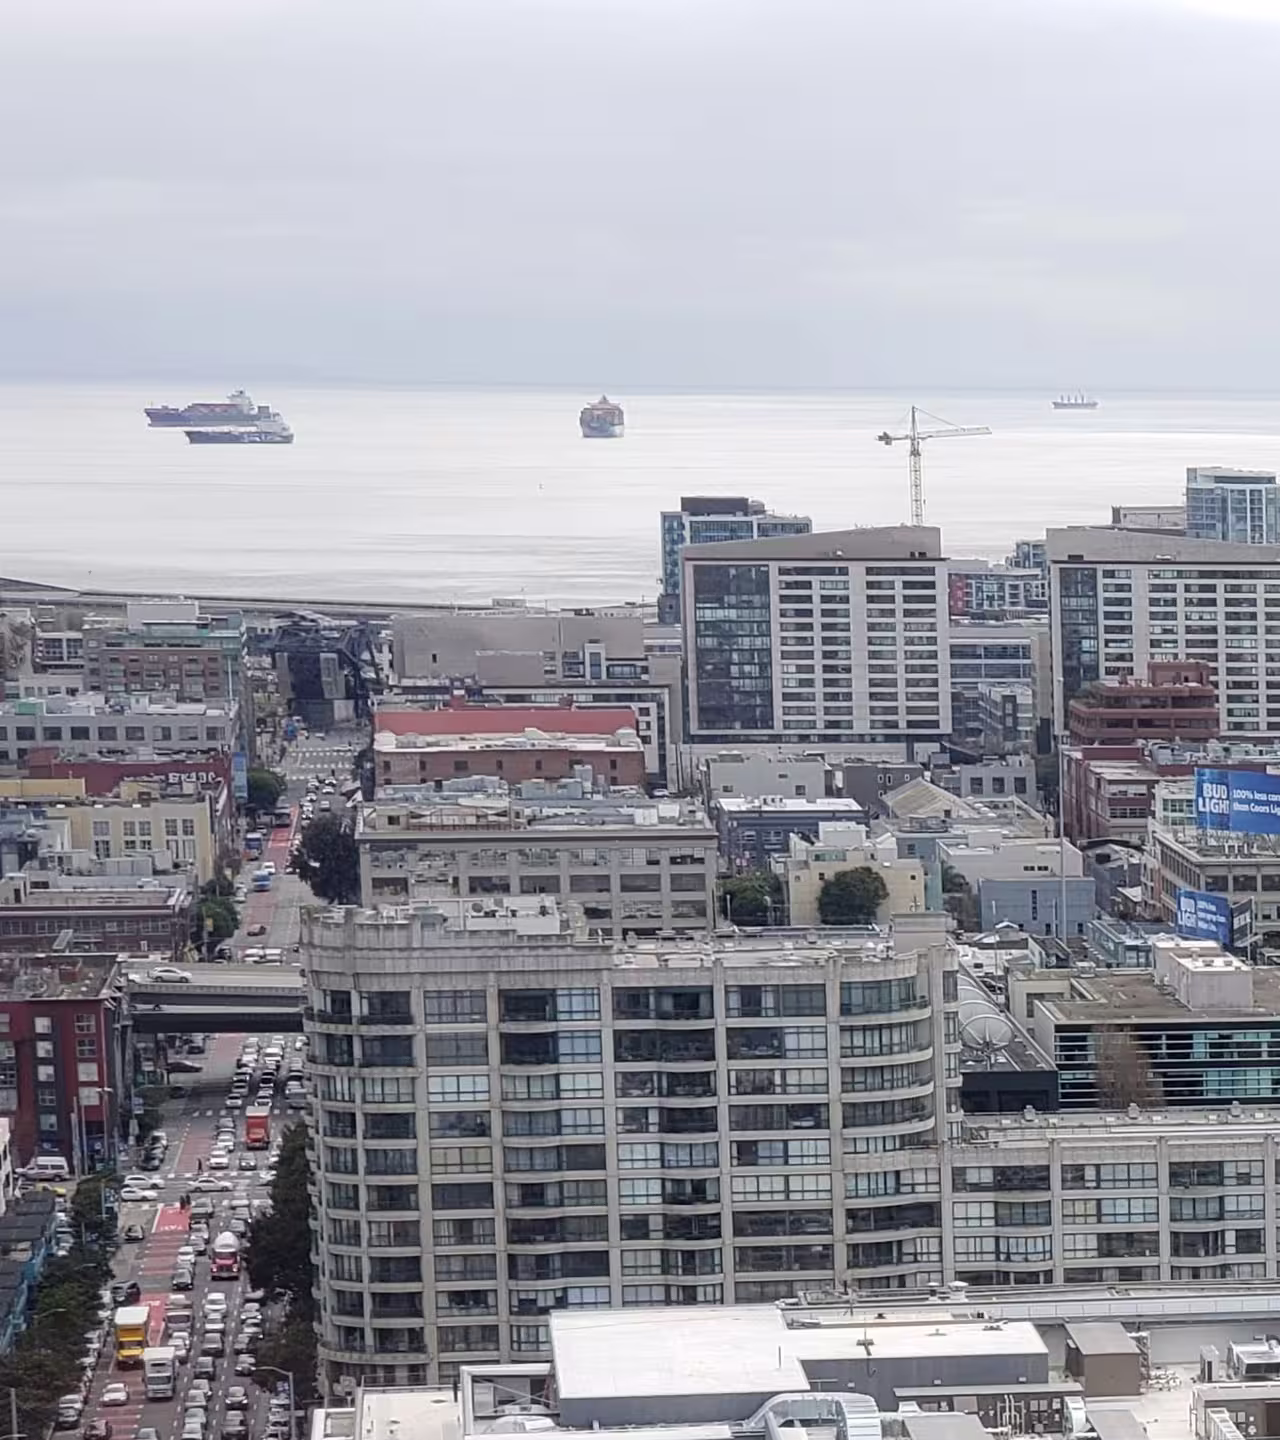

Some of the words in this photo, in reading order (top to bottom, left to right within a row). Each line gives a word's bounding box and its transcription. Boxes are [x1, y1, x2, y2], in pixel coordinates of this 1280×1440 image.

[1202, 783, 1228, 799] BUD
[1233, 789, 1253, 799] 100%
[1254, 790, 1267, 801] less
[1250, 803, 1269, 814] Coors
